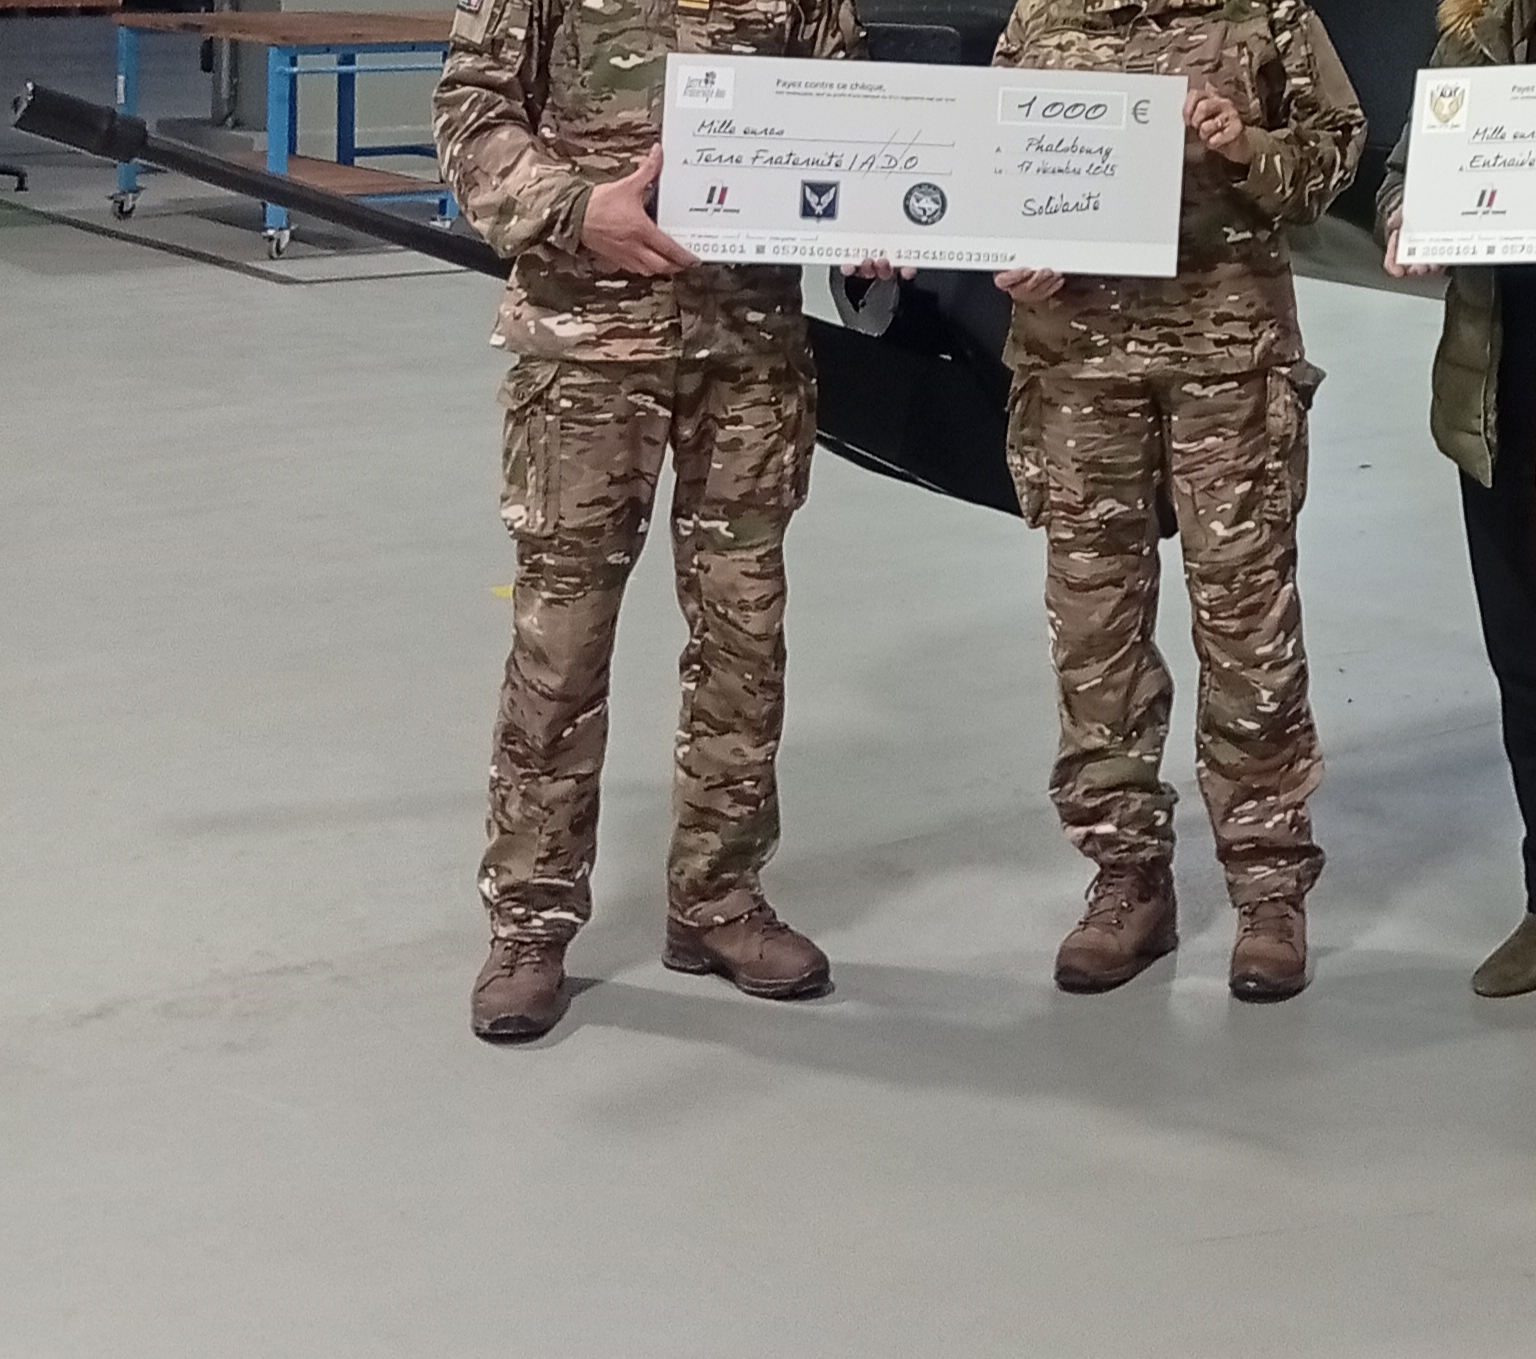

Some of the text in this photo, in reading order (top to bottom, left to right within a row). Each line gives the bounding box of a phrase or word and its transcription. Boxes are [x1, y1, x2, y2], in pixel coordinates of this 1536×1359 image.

[776, 78, 802, 90] Payez
[805, 80, 834, 89] contre
[1132, 99, 1151, 124] €
[697, 120, 736, 135] Mille
[1472, 126, 1506, 141] Mille
[696, 148, 744, 165] Terre
[751, 149, 845, 169] Fraternité
[1026, 134, 1113, 163] Phalsbourg
[1469, 150, 1536, 169] Entraide
[1021, 192, 1101, 217] Solidarité
